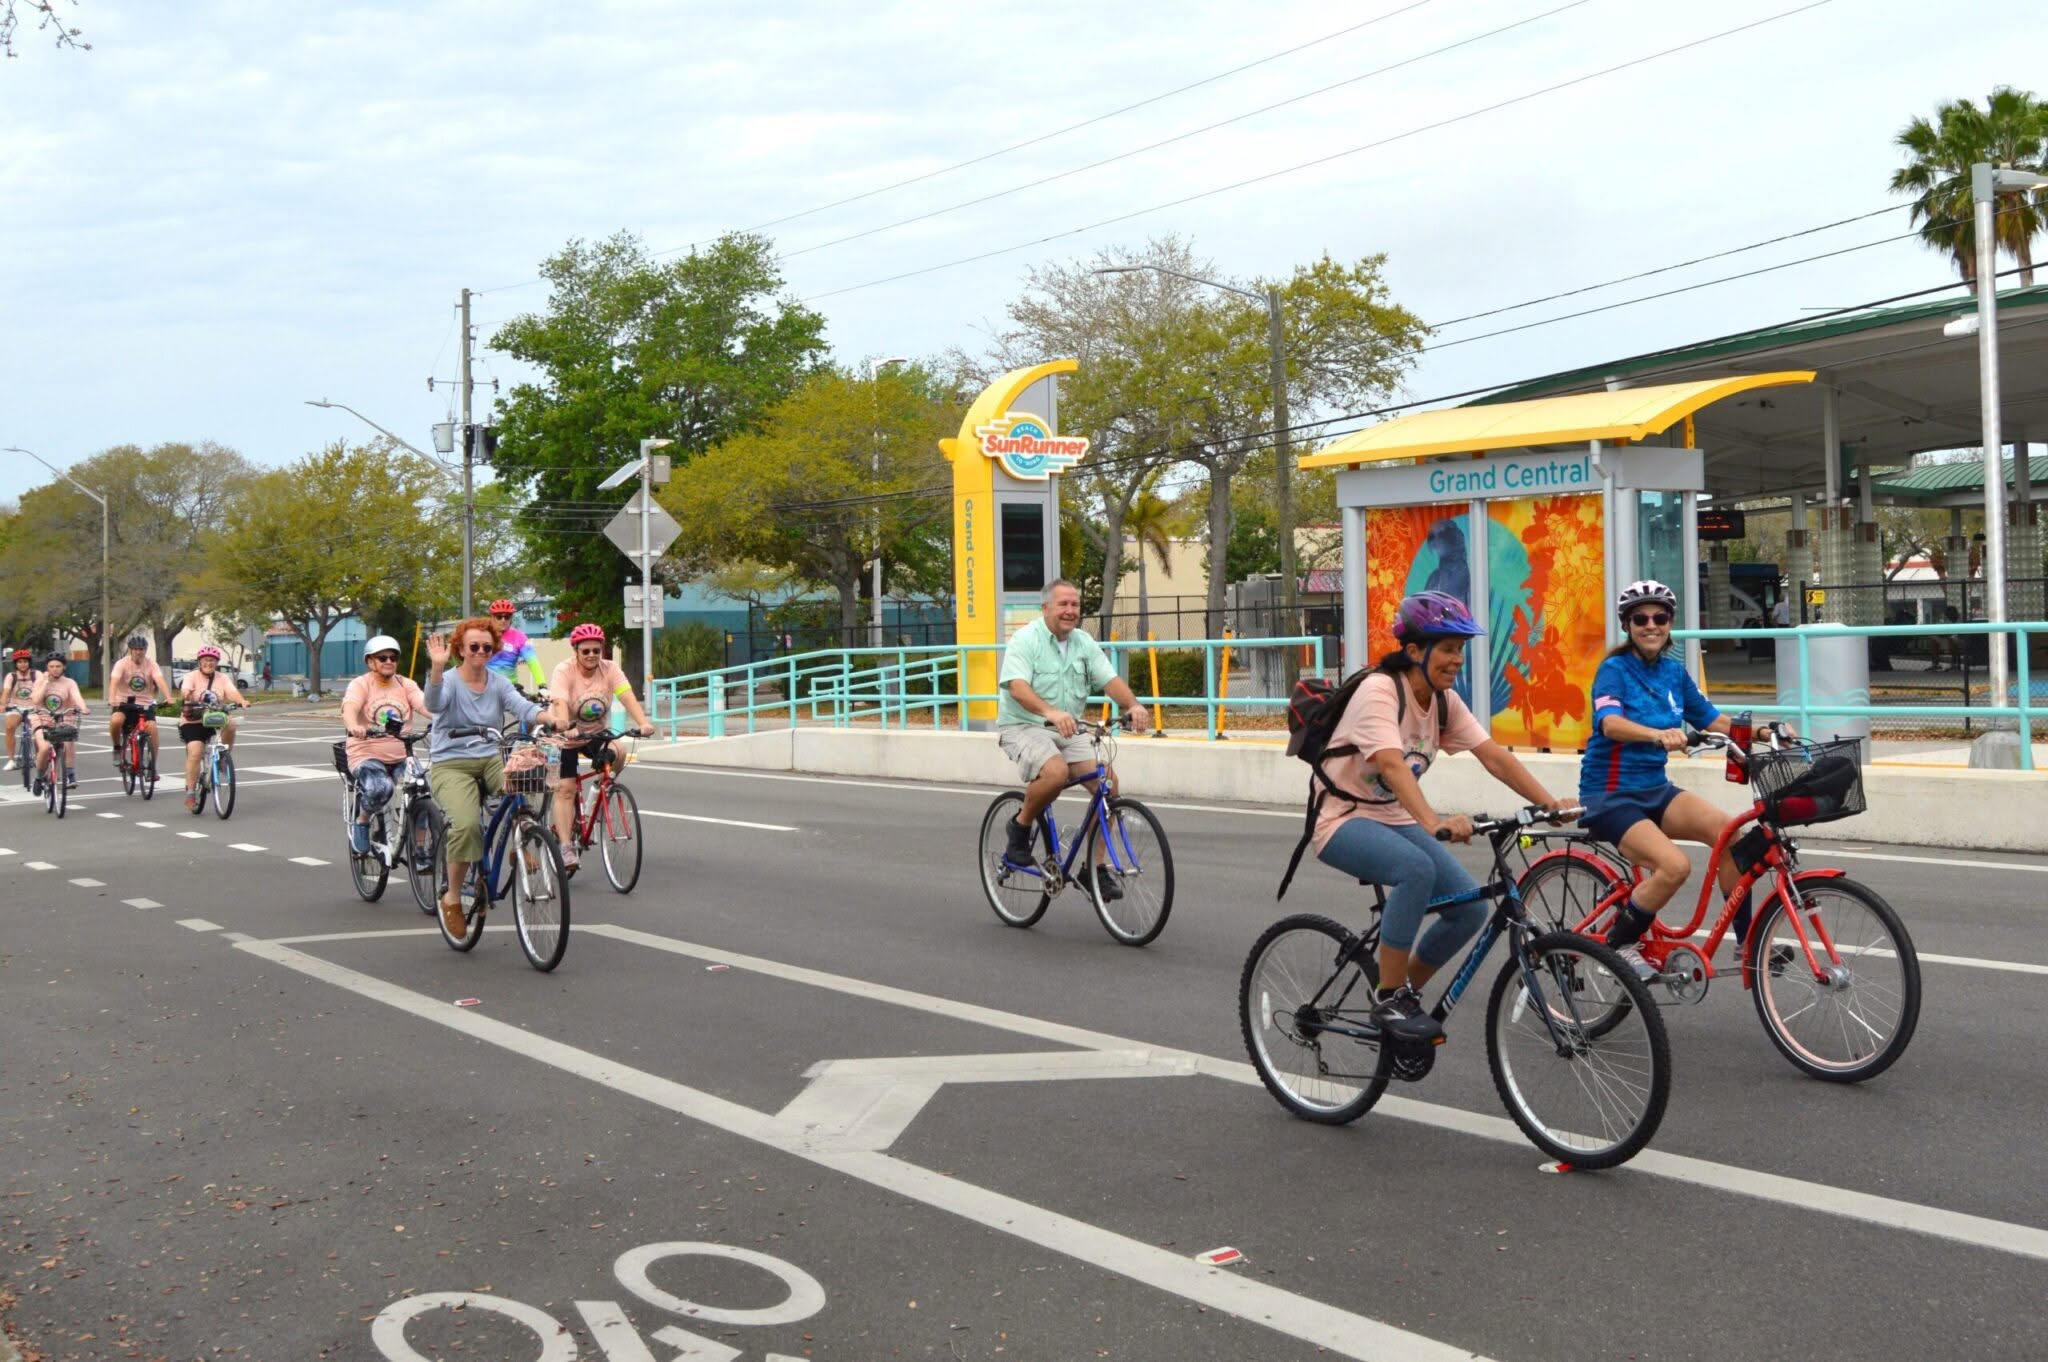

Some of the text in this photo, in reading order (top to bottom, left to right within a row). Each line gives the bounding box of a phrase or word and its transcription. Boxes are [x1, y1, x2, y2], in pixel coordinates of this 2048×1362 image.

[986, 434, 1086, 455] SunRunner
[1430, 456, 1589, 494] Grand Central
[965, 499, 976, 618] Grand Central
